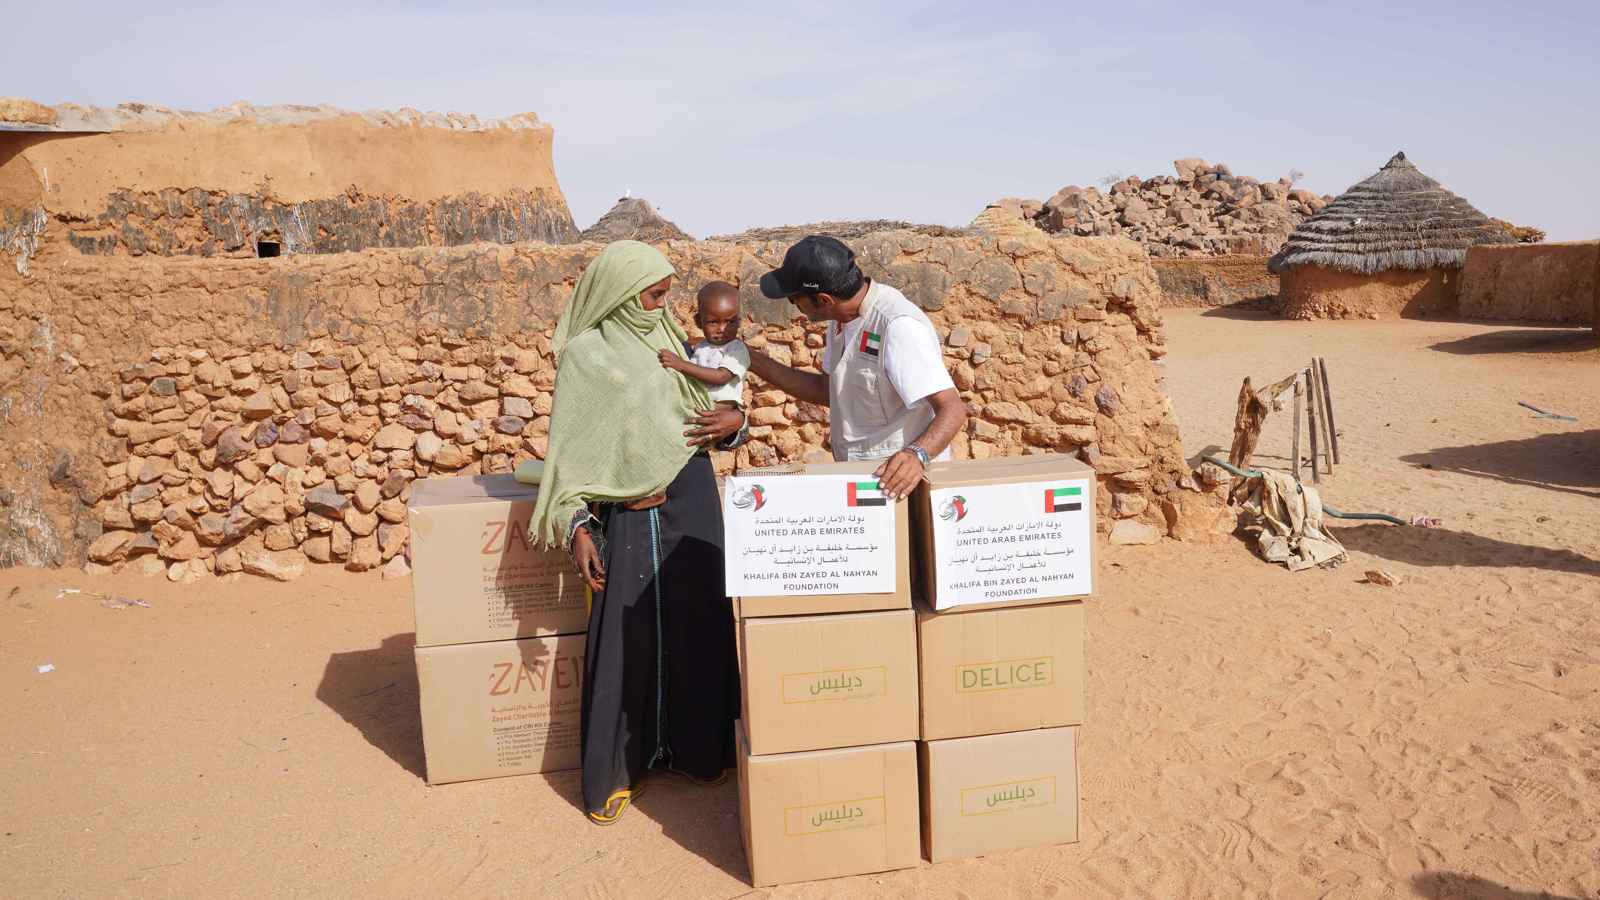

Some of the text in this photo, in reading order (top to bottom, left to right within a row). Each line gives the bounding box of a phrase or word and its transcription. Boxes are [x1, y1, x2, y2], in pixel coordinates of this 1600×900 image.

[786, 516, 814, 526] العربية
[848, 515, 864, 524] دولة
[754, 526, 865, 536] UNITED ARAB EMIRATES
[956, 532, 1062, 546] UNITED ARAB EMIRATES
[743, 569, 878, 580] KHALIFA BIN ZAYED AL NAHYAN
[783, 582, 839, 591] FOUNDATION
[949, 580, 981, 590] KHALIFA
[983, 579, 998, 587] BIN
[1000, 577, 1027, 586] ZAYED
[1041, 573, 1074, 582] NAHYAN
[984, 587, 1038, 598] FOUNDATION
[962, 662, 1049, 688] DELICE
[809, 672, 863, 695] ديليس
[986, 784, 1036, 807] ديليس
[812, 804, 864, 827] ديليس
